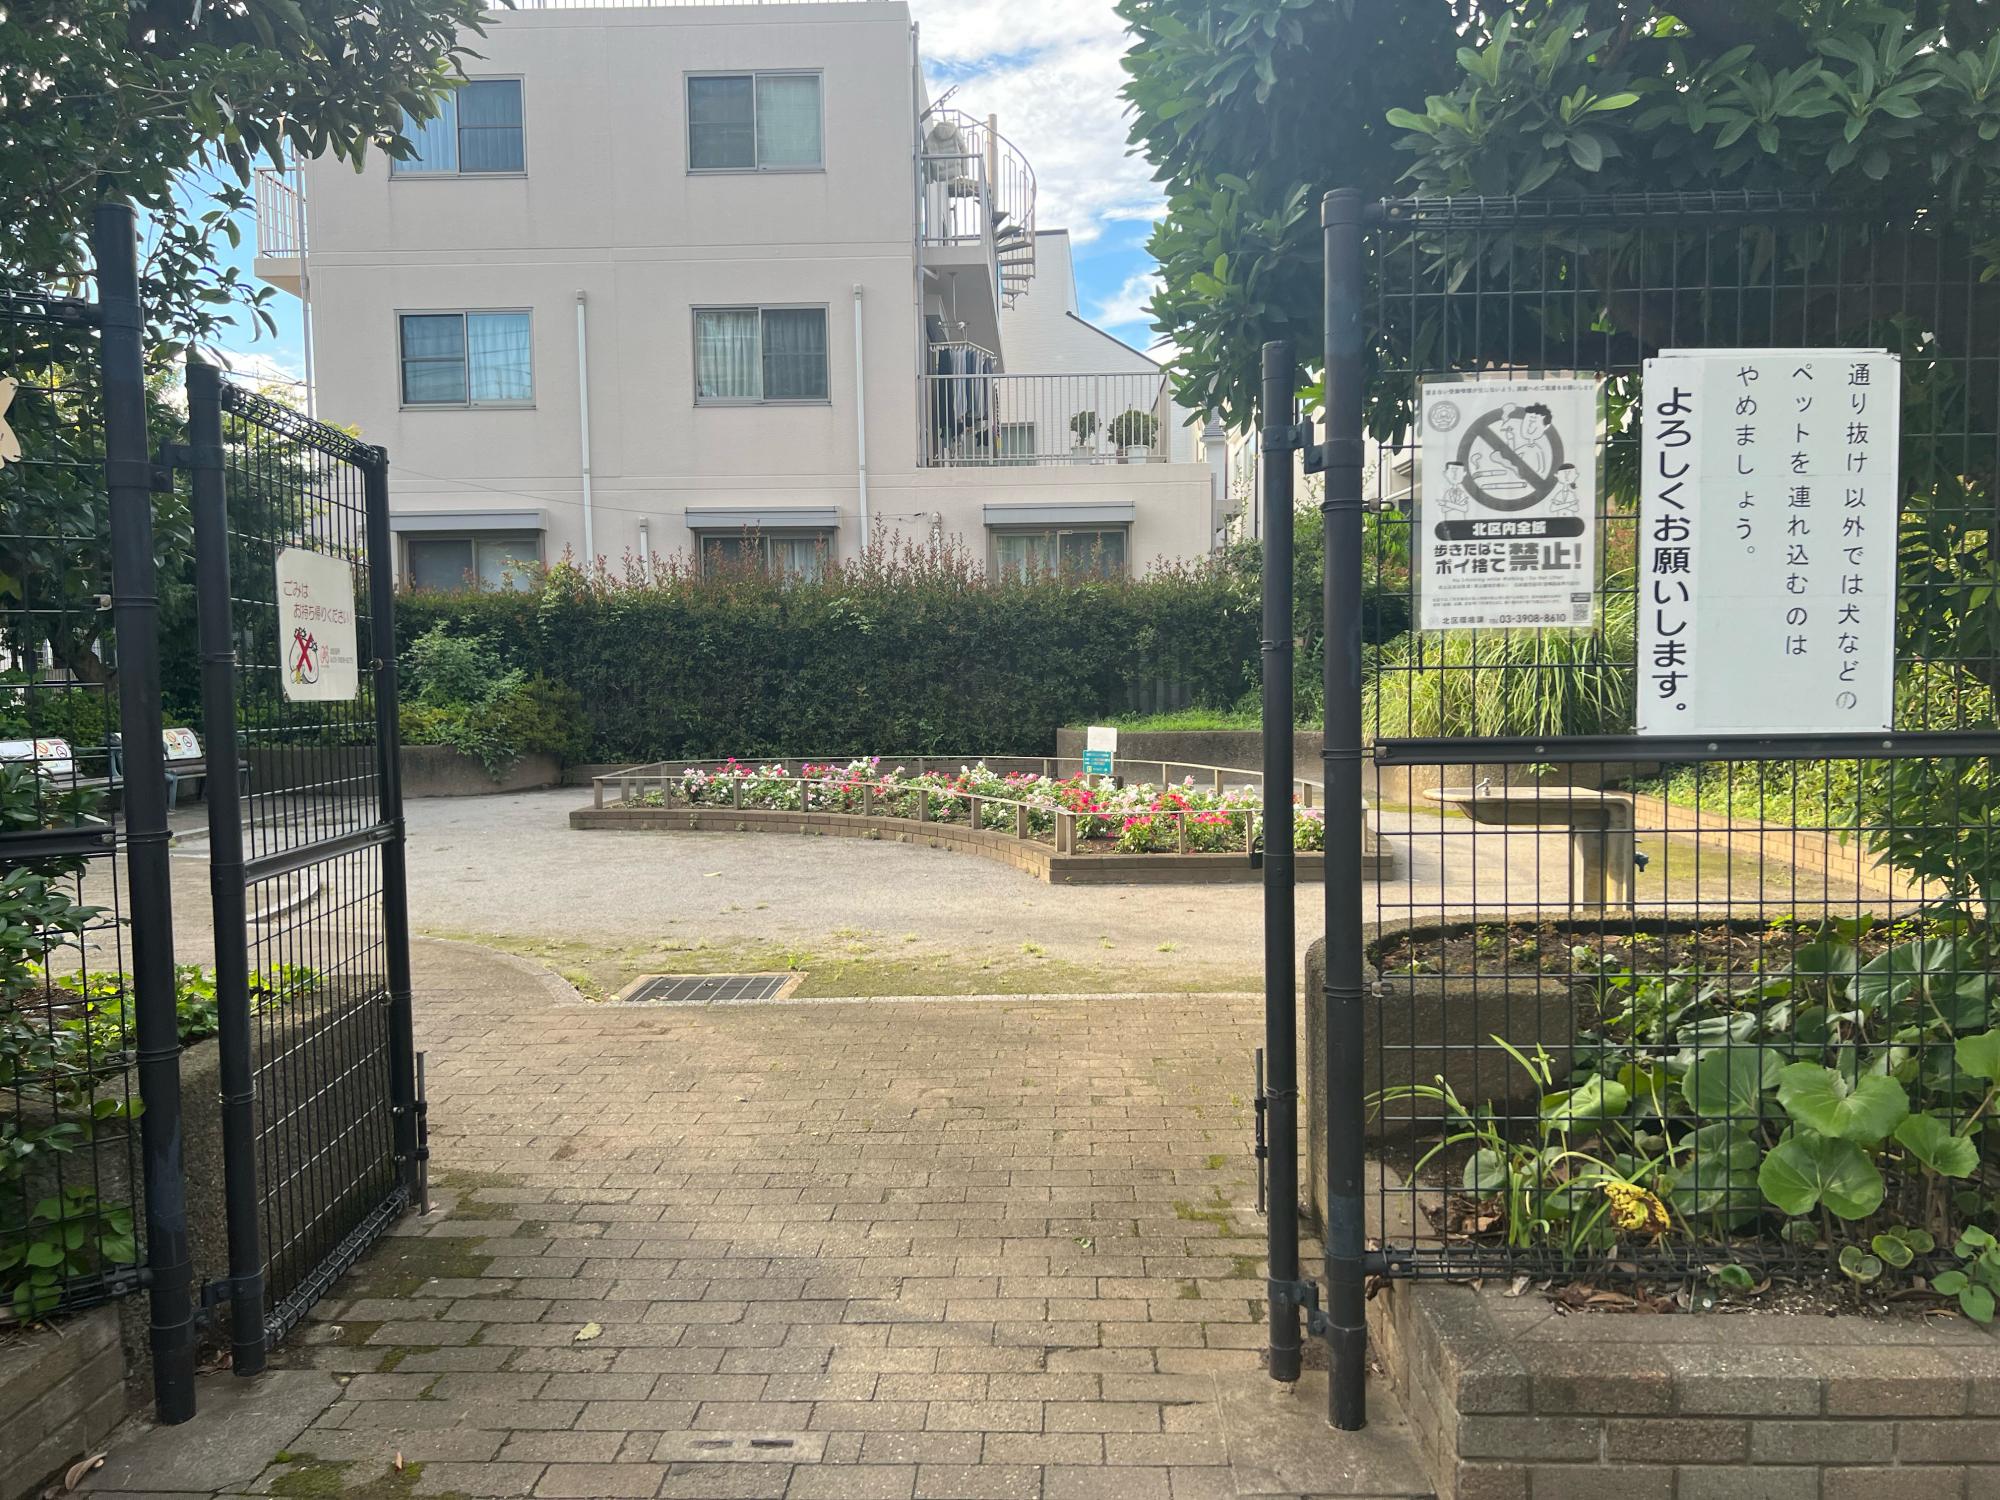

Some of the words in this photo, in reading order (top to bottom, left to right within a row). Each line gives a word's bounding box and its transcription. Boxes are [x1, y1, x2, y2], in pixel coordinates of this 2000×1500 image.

[1734, 364, 1759, 555] やめましょう。
[1785, 362, 1814, 655] ペットを連れ込むのは
[1433, 542, 1505, 558] 歩きたばこ
[1435, 557, 1505, 575] ポイ捨て
[1472, 520, 1547, 537] 北区内全域
[1651, 386, 1692, 712] よろしくお願いします。
[1834, 362, 1871, 711] 通り抜け以外では犬などの
[283, 580, 309, 598] ごみは
